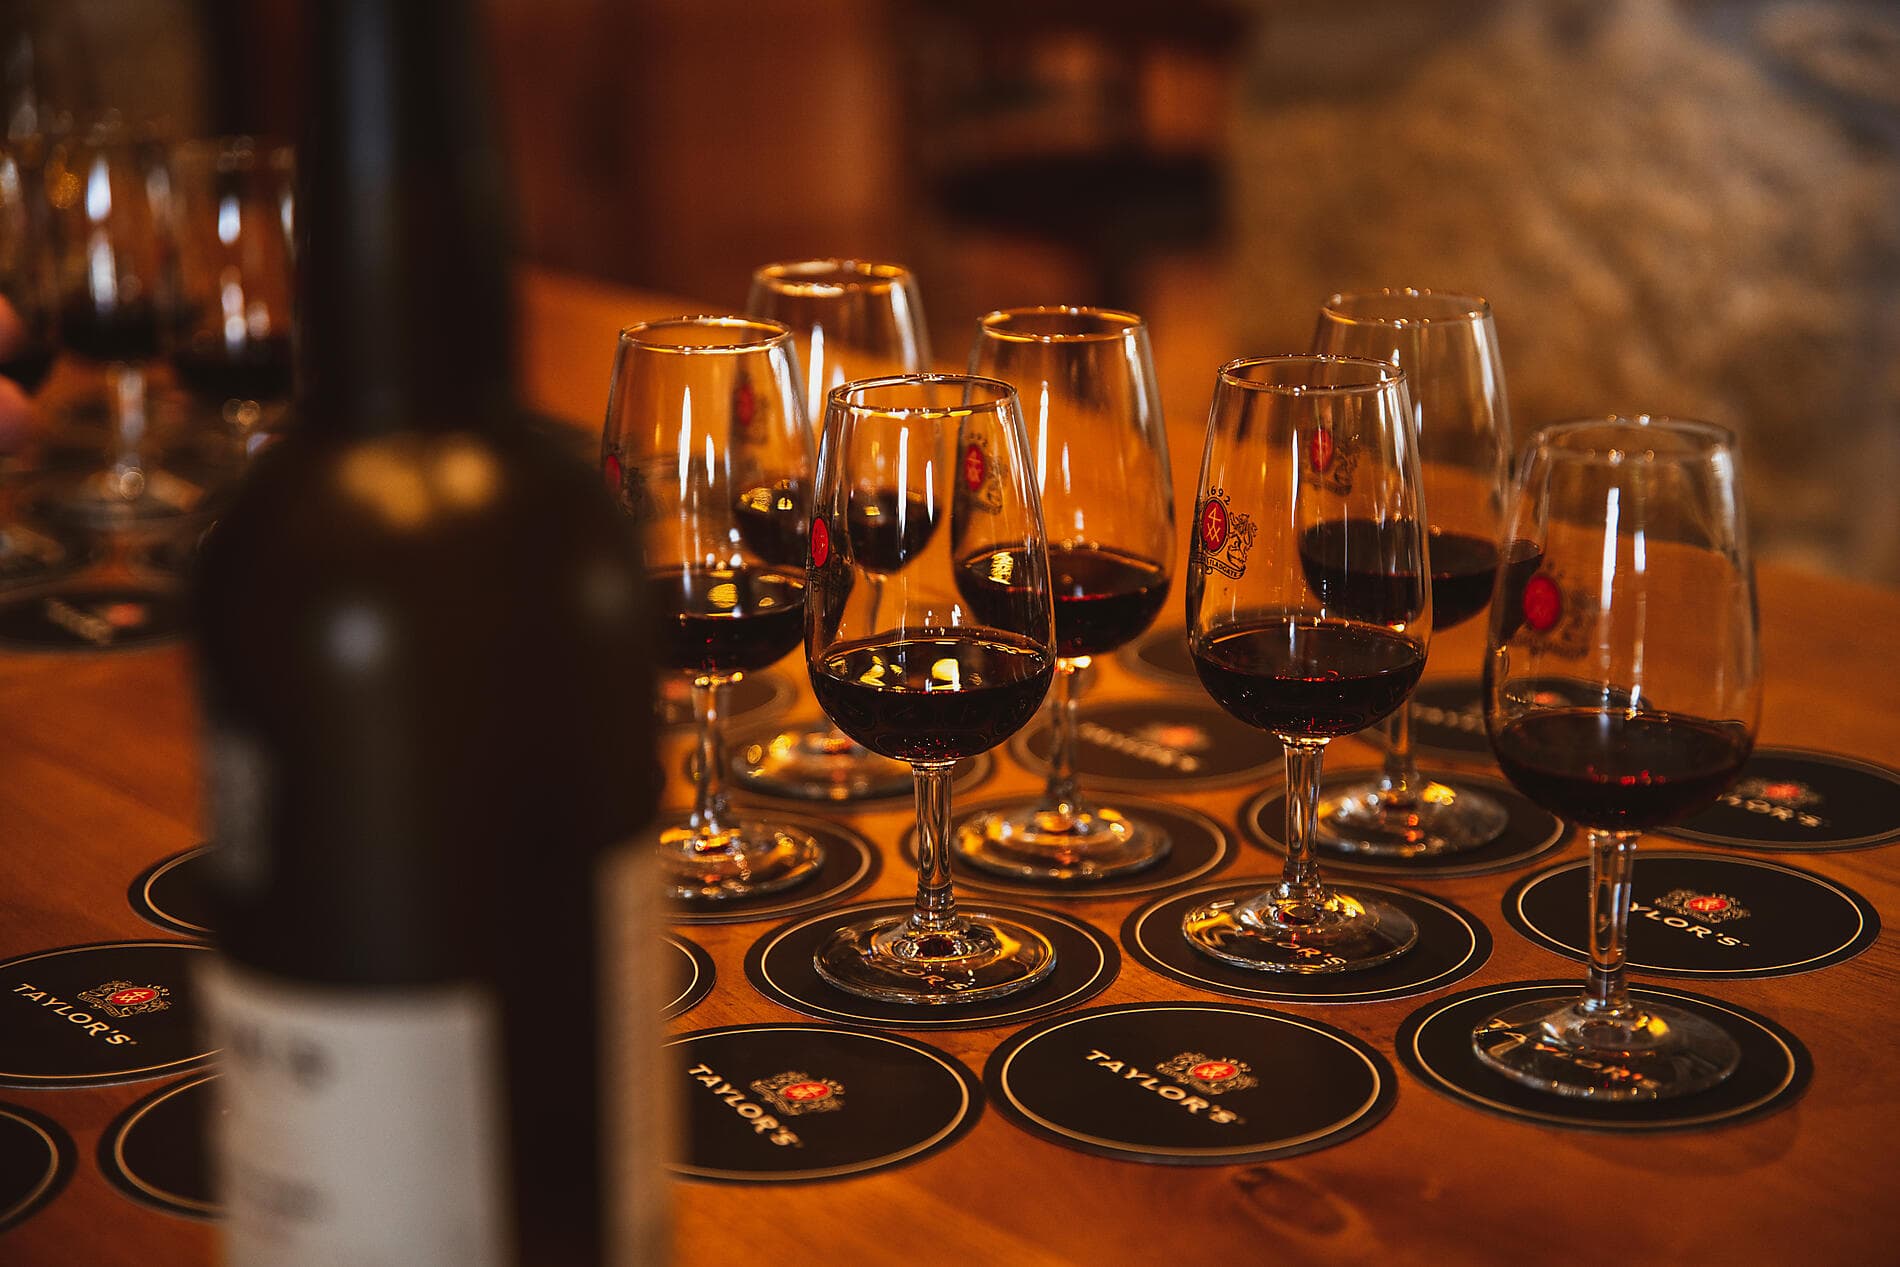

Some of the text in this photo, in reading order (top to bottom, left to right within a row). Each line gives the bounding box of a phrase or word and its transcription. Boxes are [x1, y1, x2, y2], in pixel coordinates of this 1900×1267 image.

[1630, 901, 1742, 947] YLOR'S
[13, 983, 133, 1046] TAYLOR'S
[688, 1063, 800, 1146] TAYLOR'S
[1086, 1050, 1238, 1124] TAYLOR'S
